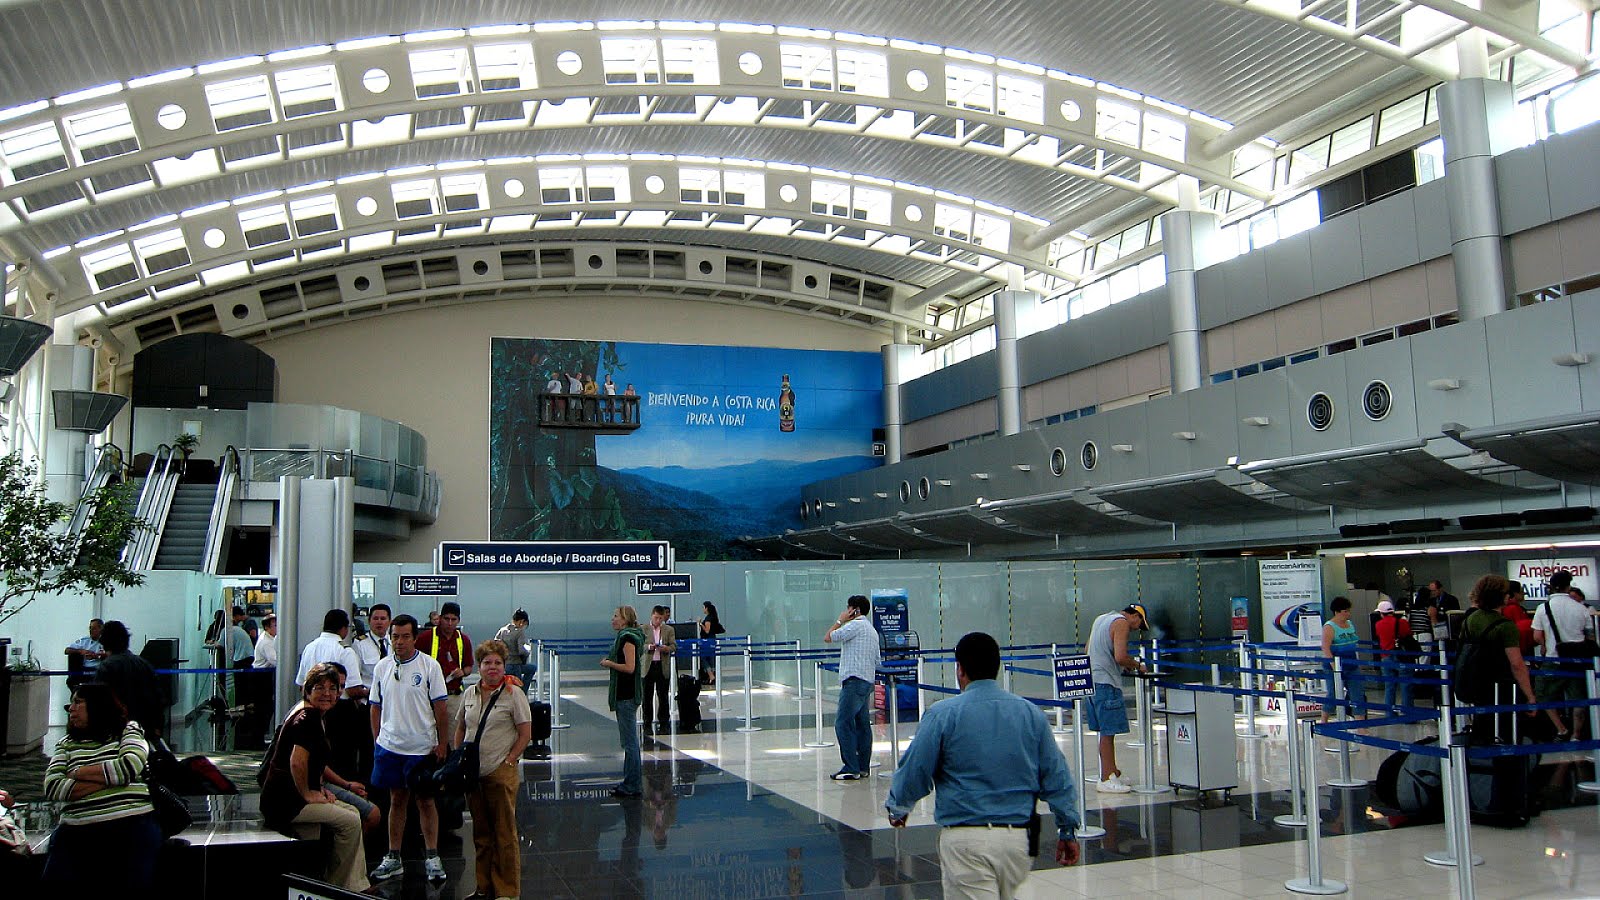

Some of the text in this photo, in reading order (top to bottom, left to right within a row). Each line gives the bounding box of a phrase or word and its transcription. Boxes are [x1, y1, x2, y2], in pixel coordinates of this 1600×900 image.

[648, 392, 776, 411] BIENVENIDO A COSTA RICA
[719, 414, 745, 426] VIDA!
[467, 553, 496, 564] Salas
[499, 553, 513, 564] de
[515, 553, 563, 566] Abordaje
[572, 553, 619, 566] Boarding
[622, 553, 651, 564] Gates
[1060, 690, 1084, 698] DEPARTURE
